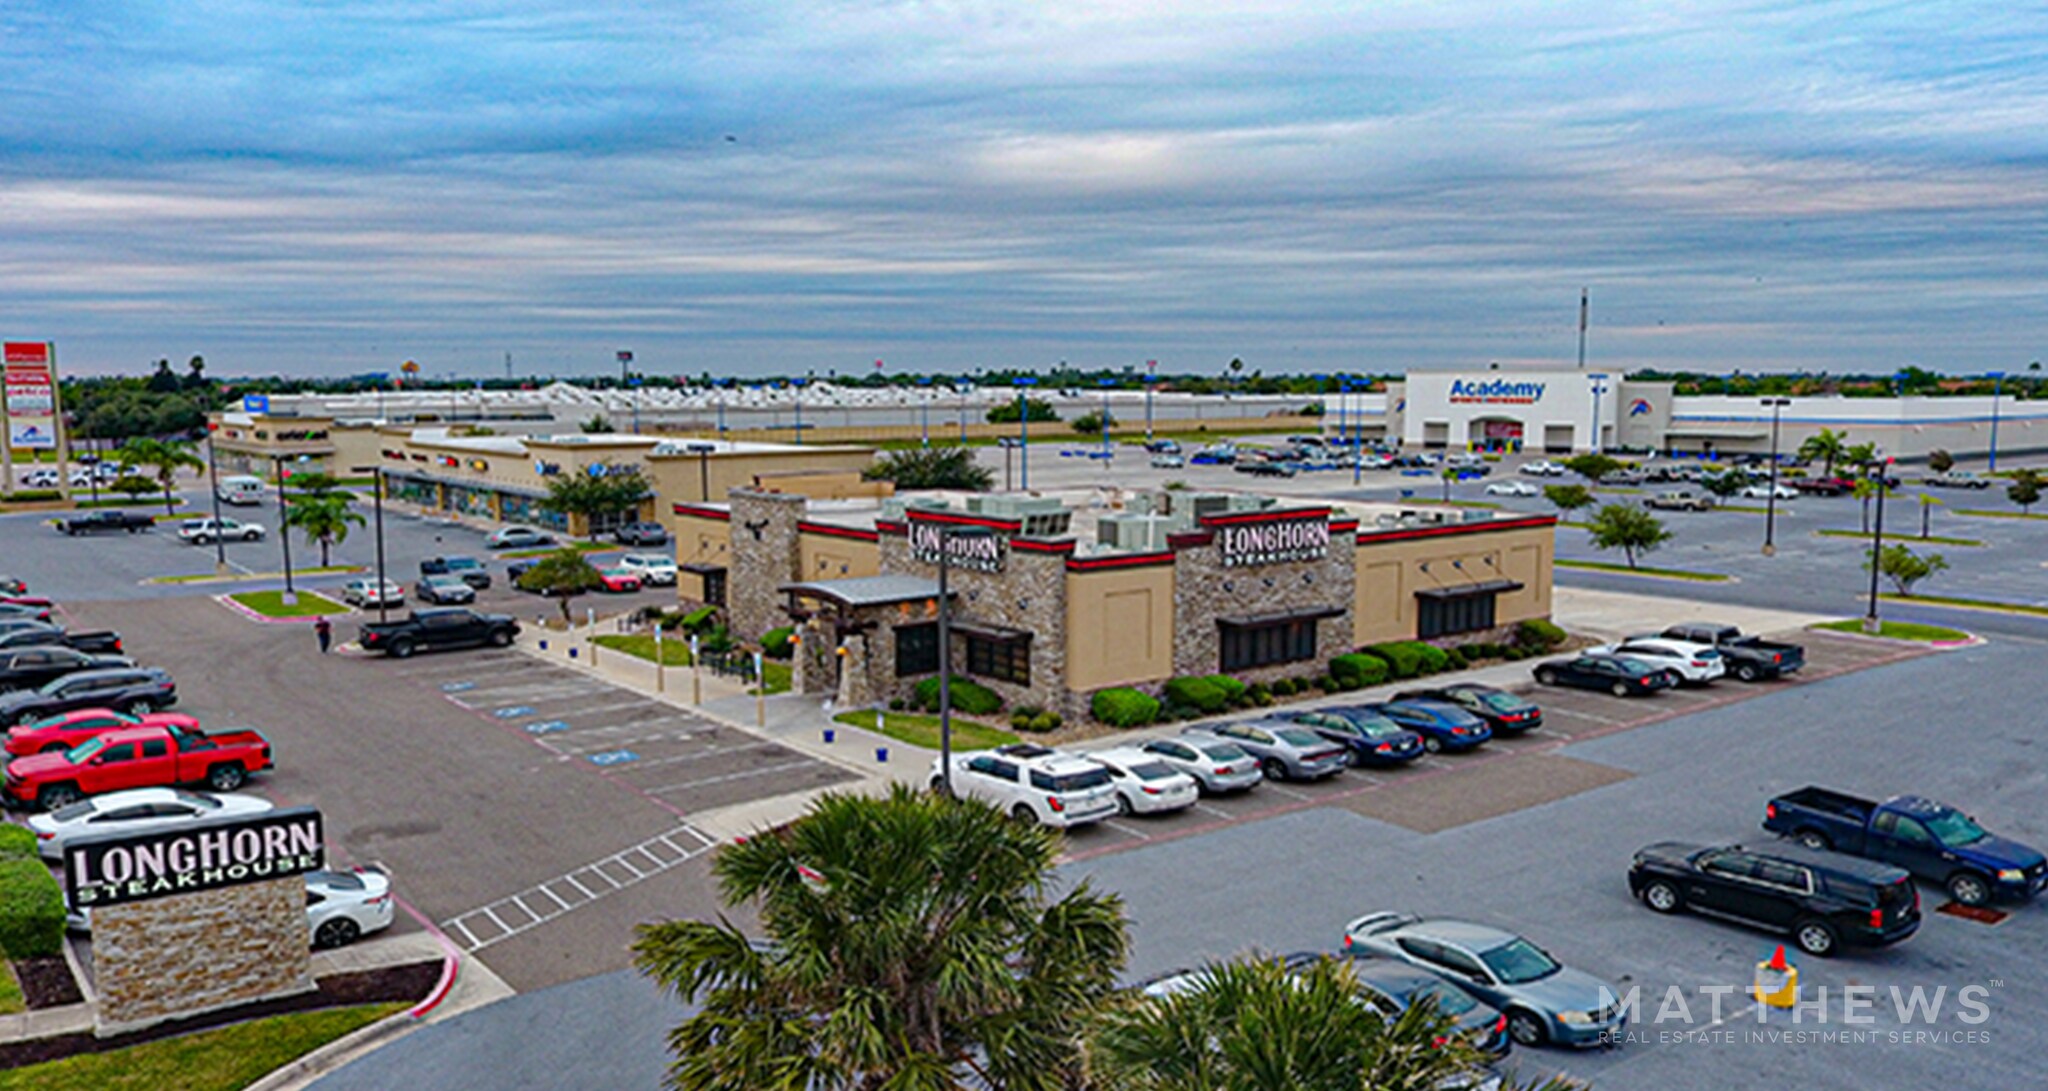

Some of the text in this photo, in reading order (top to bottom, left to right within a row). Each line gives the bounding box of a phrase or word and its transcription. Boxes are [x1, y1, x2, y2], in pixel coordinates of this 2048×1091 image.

[1450, 379, 1545, 401] Academy
[1225, 521, 1329, 554] LONGHORN
[74, 821, 316, 887] LONGHORN
[77, 854, 316, 903] STEAKHOUSE
